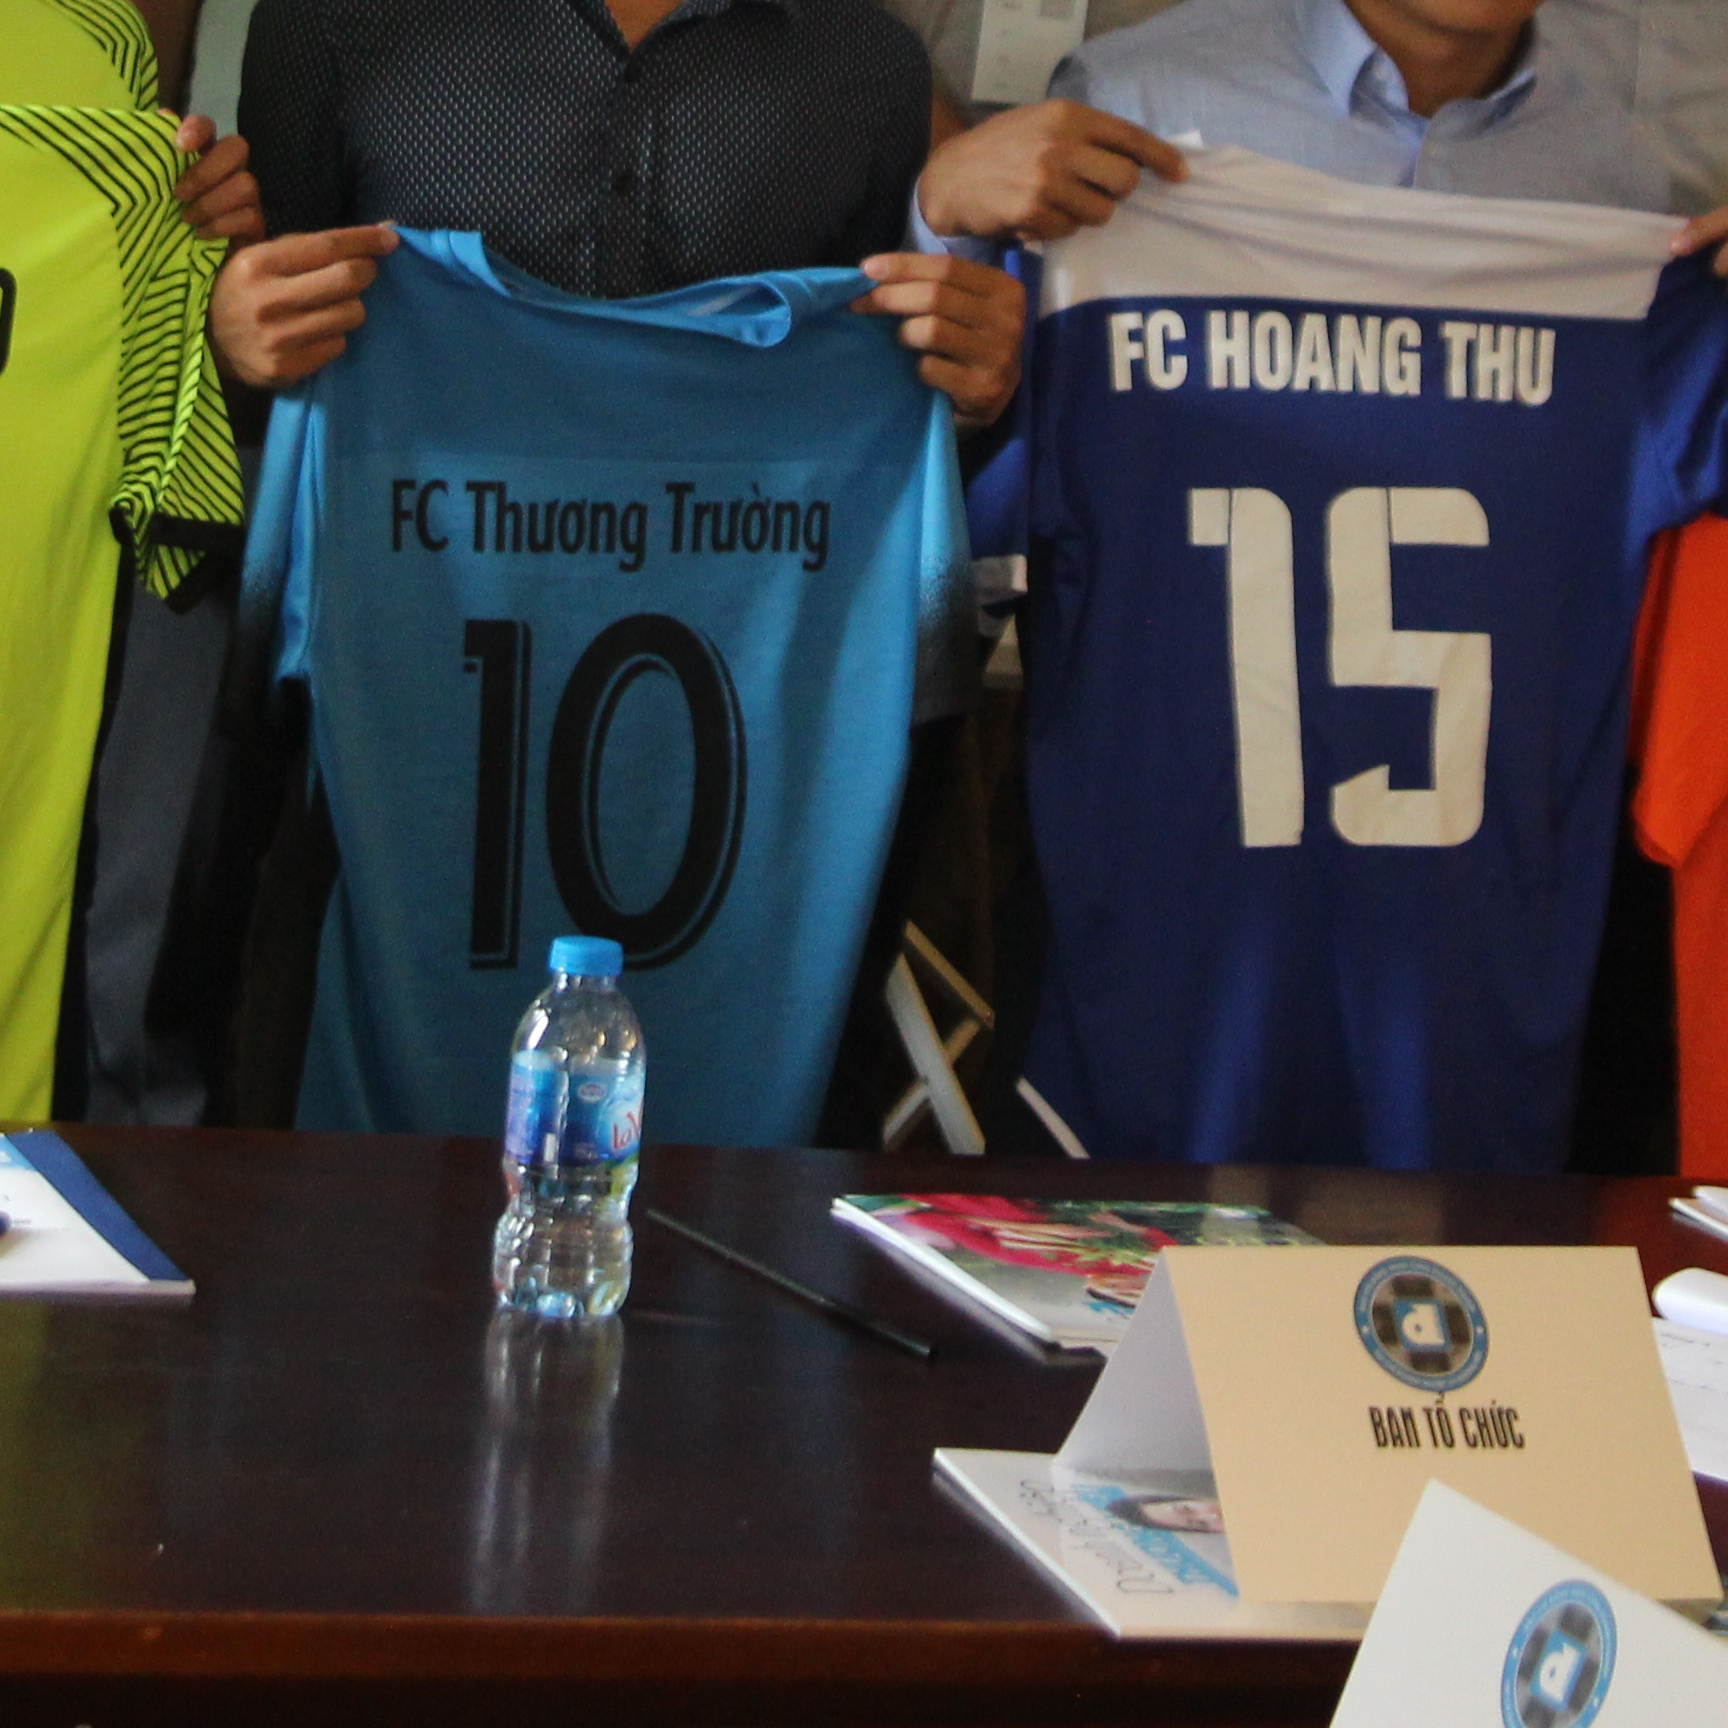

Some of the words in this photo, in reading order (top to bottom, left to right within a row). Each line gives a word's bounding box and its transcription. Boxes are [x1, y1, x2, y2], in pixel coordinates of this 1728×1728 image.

[1107, 310, 1189, 392] FC
[1207, 310, 1423, 396] HOANG
[1441, 322, 1556, 407] THU
[391, 478, 450, 552] FC
[466, 479, 649, 573] Thương
[666, 480, 832, 572] Trường
[1187, 487, 1493, 848] 15
[463, 613, 748, 971] 10
[1369, 1406, 1420, 1448] BAN
[1423, 1391, 1455, 1448] TỔ
[1459, 1399, 1525, 1449] CHỨC
